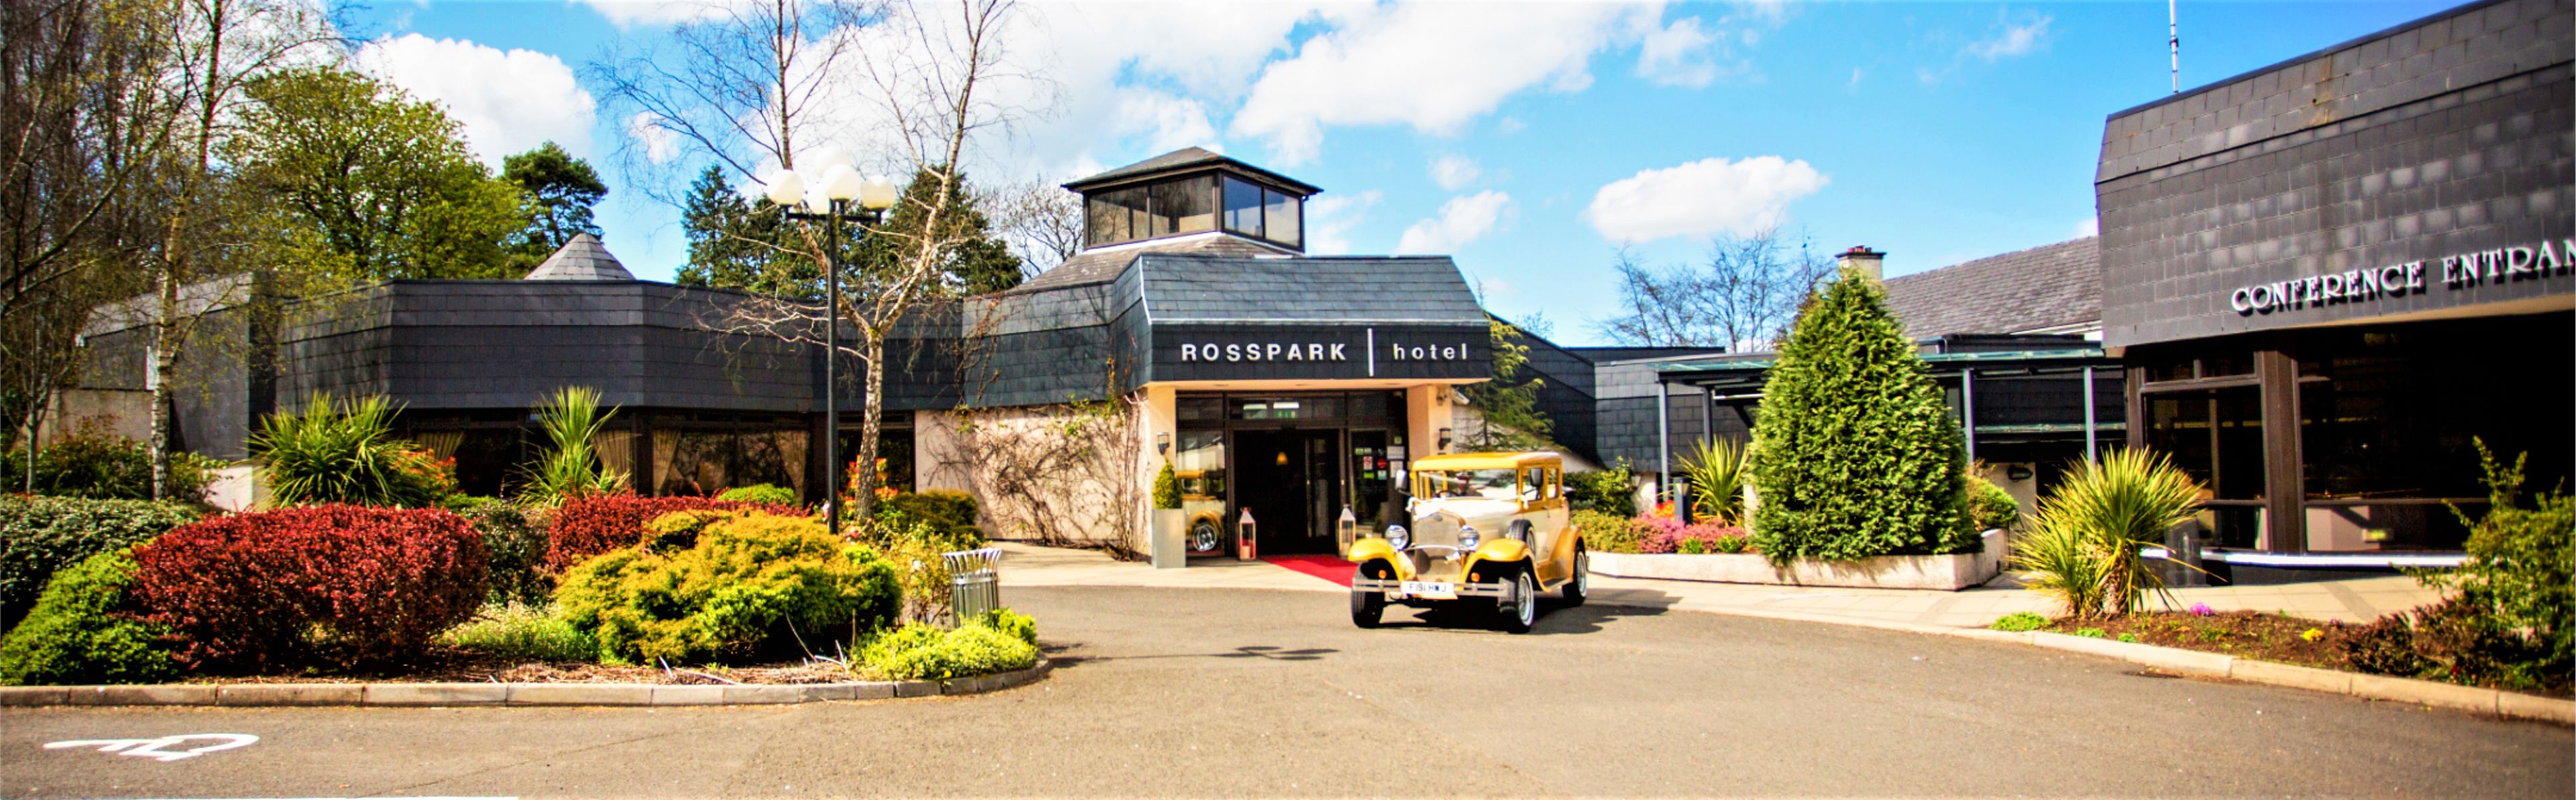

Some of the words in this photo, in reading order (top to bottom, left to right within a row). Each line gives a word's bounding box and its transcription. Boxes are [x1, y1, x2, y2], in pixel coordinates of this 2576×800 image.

[2231, 260, 2422, 312] CONFERENCE
[1181, 343, 1346, 361] ROSSPARK
[1393, 343, 1468, 361] hotel
